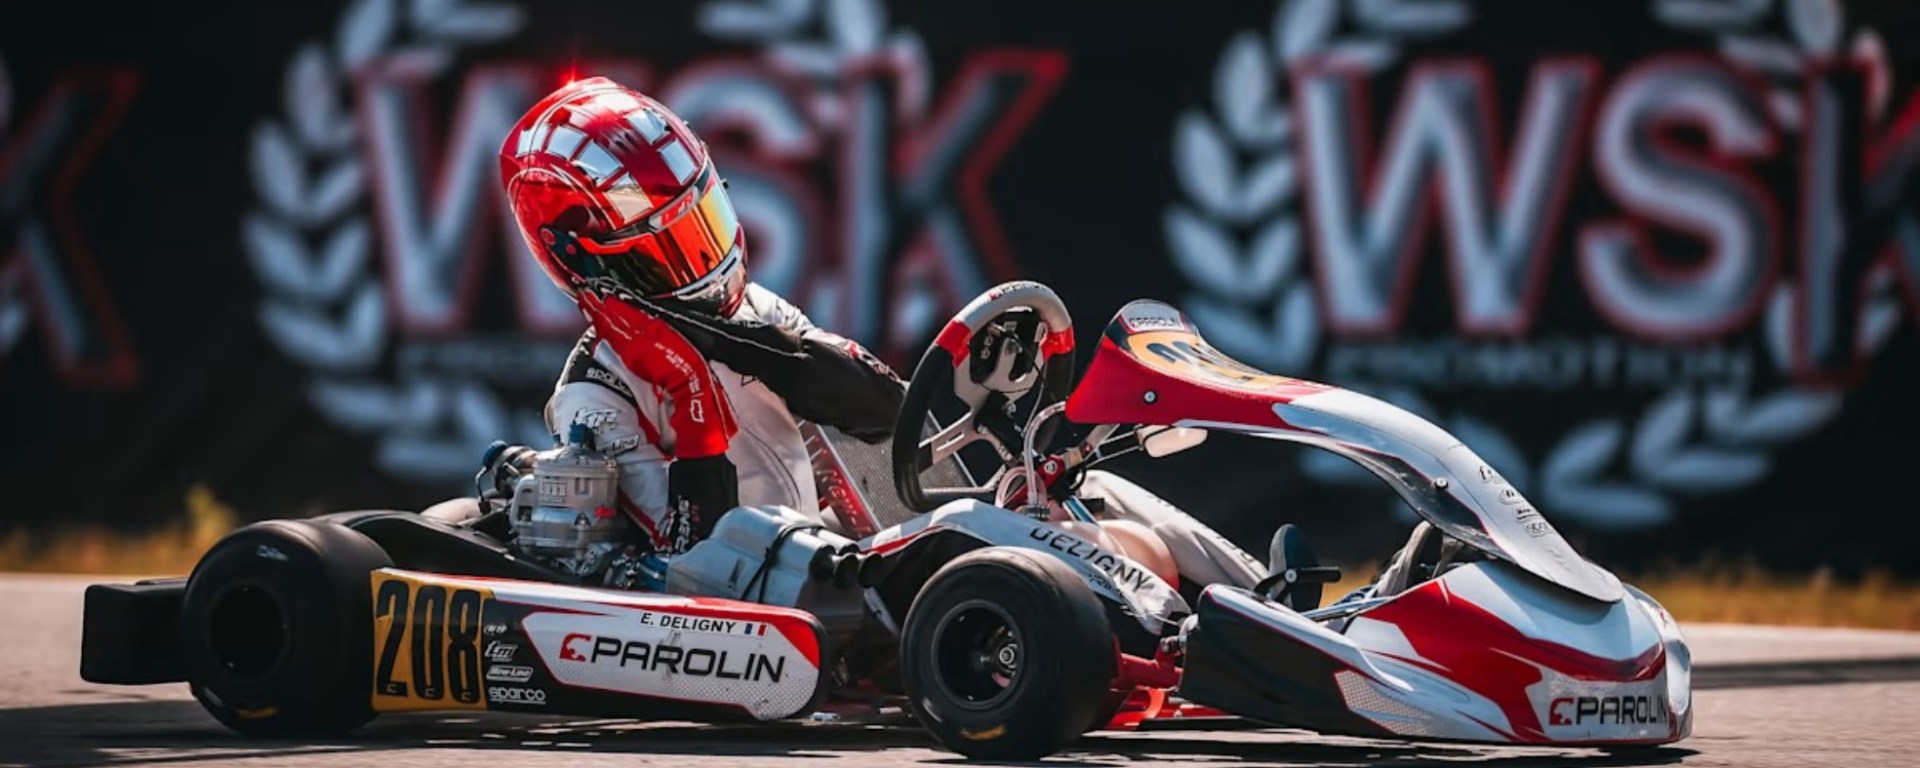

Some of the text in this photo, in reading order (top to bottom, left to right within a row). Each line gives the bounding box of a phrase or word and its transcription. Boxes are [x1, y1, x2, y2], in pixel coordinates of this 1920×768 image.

[354, 48, 1068, 336] WSK
[1325, 340, 1753, 388] PROMOTION
[1030, 526, 1154, 593] DELIGNY
[375, 579, 482, 703] 208
[640, 612, 737, 634] E. DELIGNY
[590, 637, 786, 684] PAROLIN
[488, 687, 546, 703] sparco
[1575, 695, 1669, 726] PAROLIN
